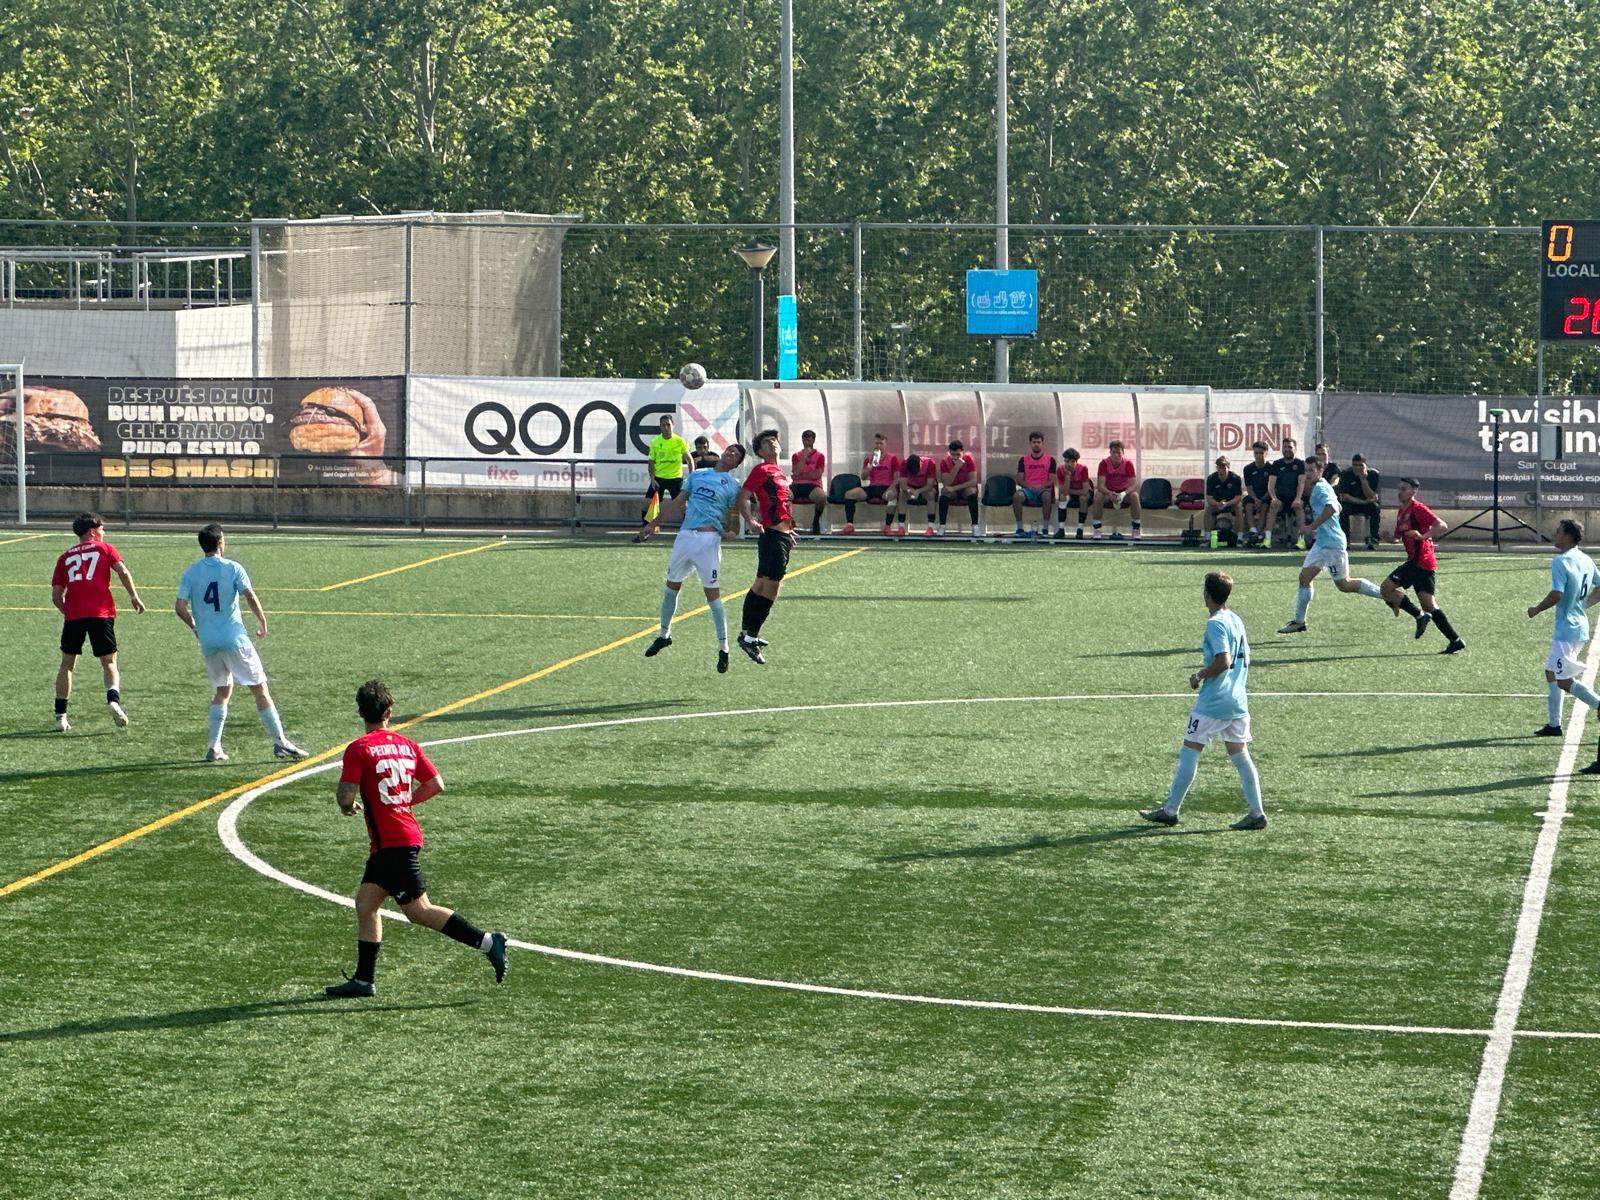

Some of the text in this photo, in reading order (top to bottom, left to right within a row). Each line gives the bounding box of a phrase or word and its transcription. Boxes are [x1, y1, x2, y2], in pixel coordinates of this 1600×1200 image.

[1547, 225, 1574, 262] 0
[1546, 263, 1600, 277] LOCAL
[108, 385, 273, 404] DESPUÉS DE UN
[108, 405, 274, 424] BUEN PARTIDO,
[117, 420, 264, 439] CELÉBRALO AL
[969, 425, 1010, 447] PPE
[1081, 422, 1293, 451] BERNARDINI
[121, 441, 260, 454] PURO ESTILO
[487, 465, 520, 481] fixe
[1544, 460, 1577, 472] Cugat
[65, 551, 100, 583] 27
[203, 580, 221, 613] 4
[1580, 573, 1588, 601] 6
[1229, 635, 1248, 670] 14
[1557, 658, 1563, 669] 6
[1187, 717, 1200, 732] 14
[369, 743, 398, 757] PEDRO
[375, 758, 416, 805] 25
